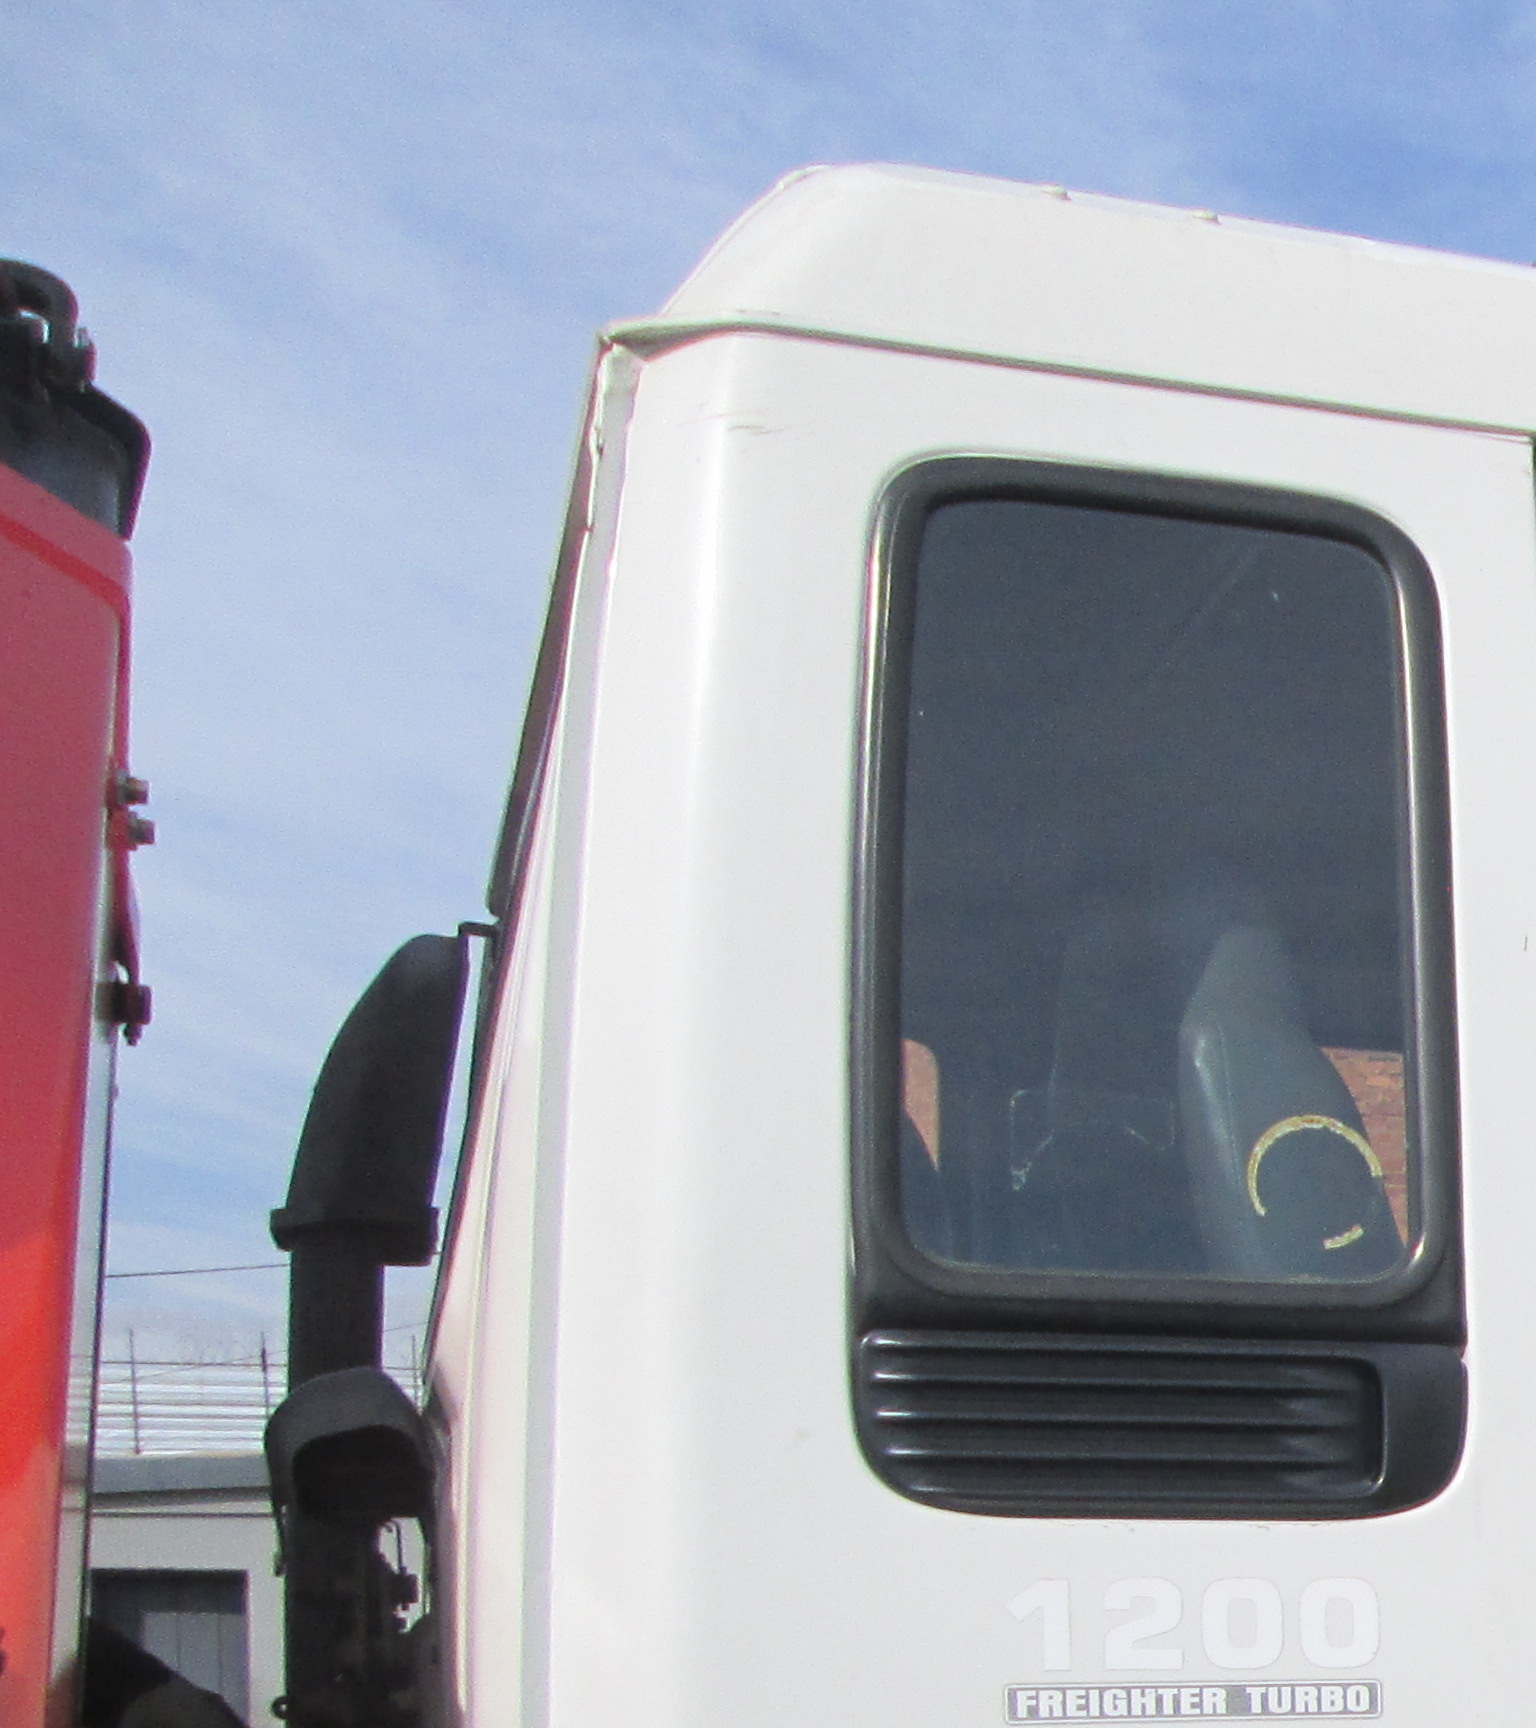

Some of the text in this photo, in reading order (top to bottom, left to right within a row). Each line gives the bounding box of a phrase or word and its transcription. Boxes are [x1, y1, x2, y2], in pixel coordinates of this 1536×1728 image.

[1005, 1577, 1380, 1671] 1200
[1016, 1685, 1370, 1718] FREIGHTER TURBO
